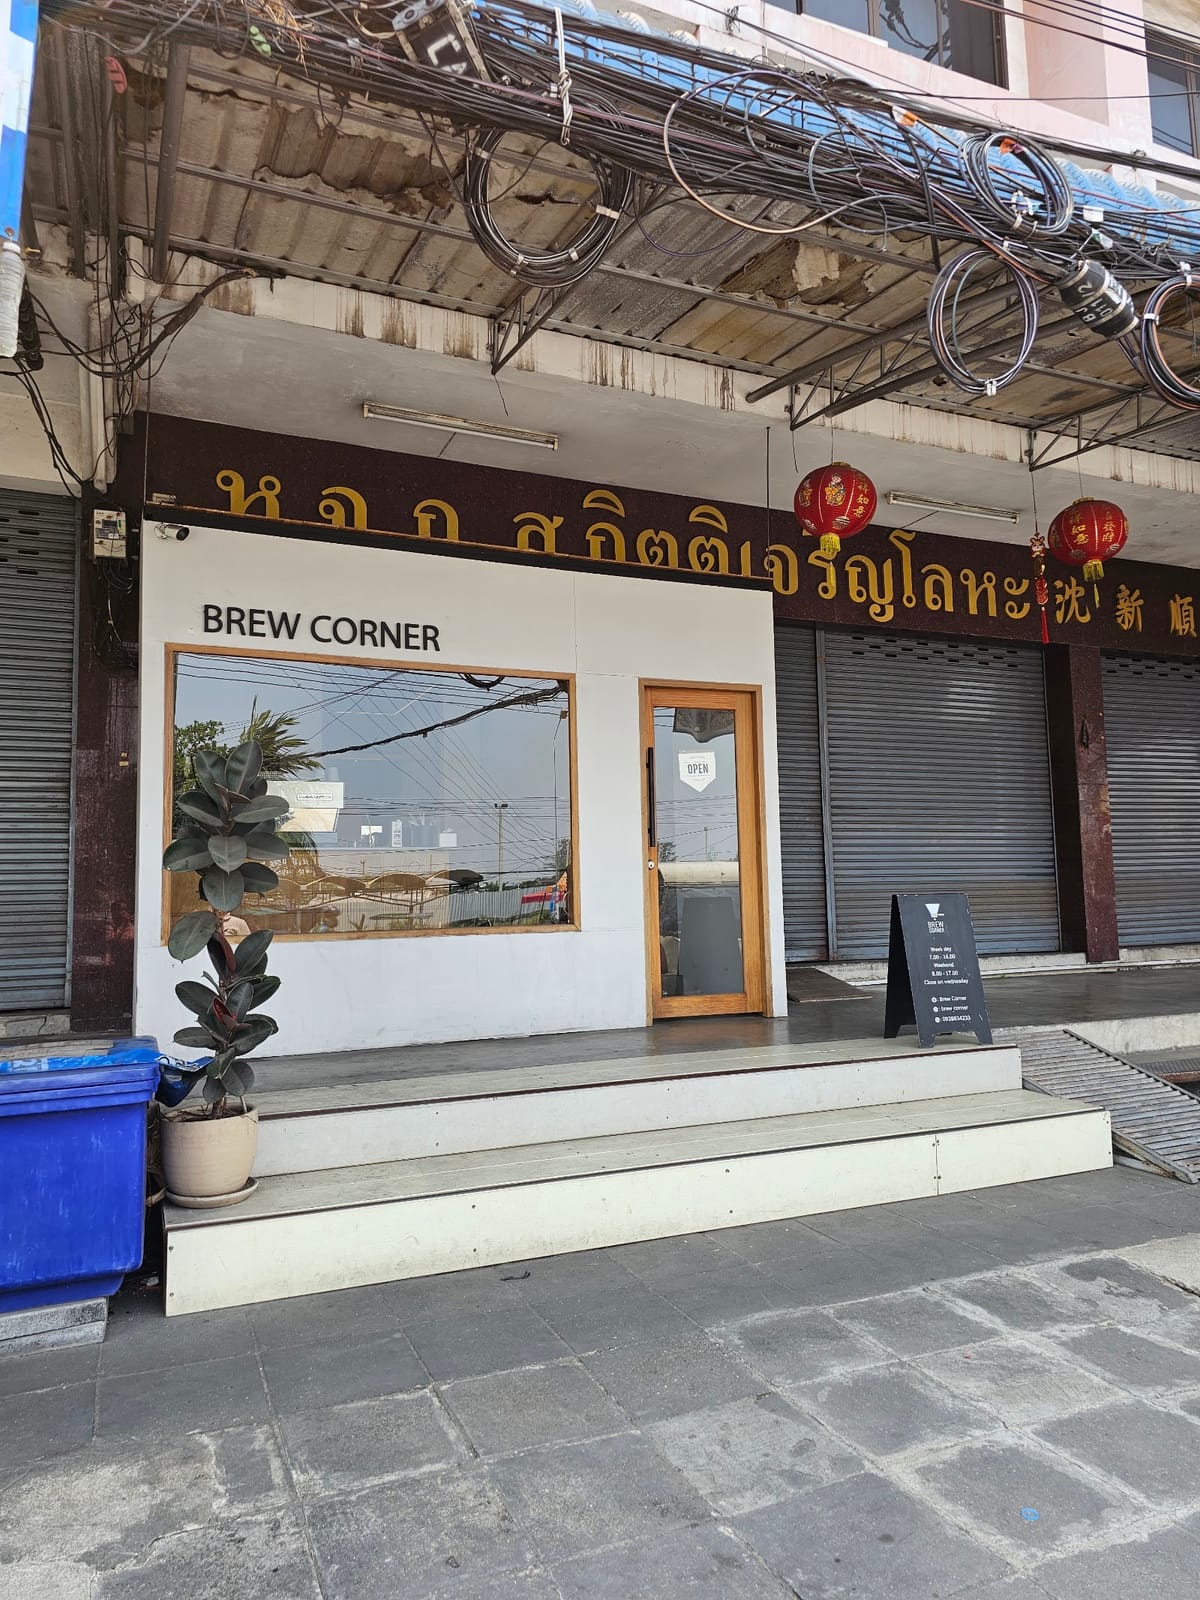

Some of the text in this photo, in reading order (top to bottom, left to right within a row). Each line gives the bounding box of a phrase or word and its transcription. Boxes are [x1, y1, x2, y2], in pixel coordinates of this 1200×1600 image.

[203, 603, 441, 652] BREW CORNER
[687, 763, 709, 775] OPEN
